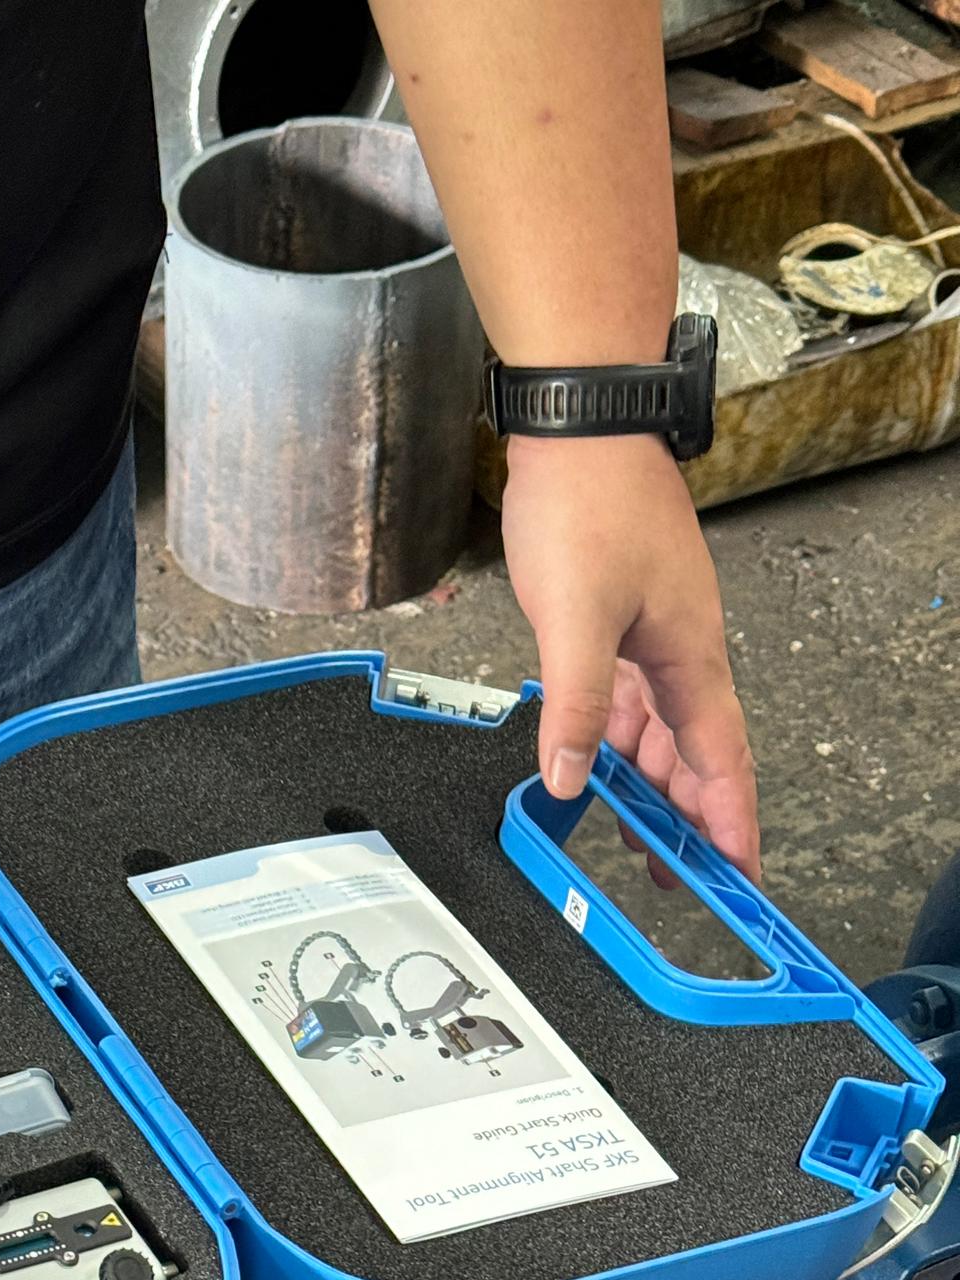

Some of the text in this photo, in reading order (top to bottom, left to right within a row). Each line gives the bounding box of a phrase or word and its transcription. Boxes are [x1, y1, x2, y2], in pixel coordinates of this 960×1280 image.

[516, 1089, 571, 1105] Description
[472, 1107, 603, 1143] Quick Start Guide
[525, 1128, 626, 1160] TKSA 51
[405, 1149, 639, 1212] SKF Shaft Alignment Tool
